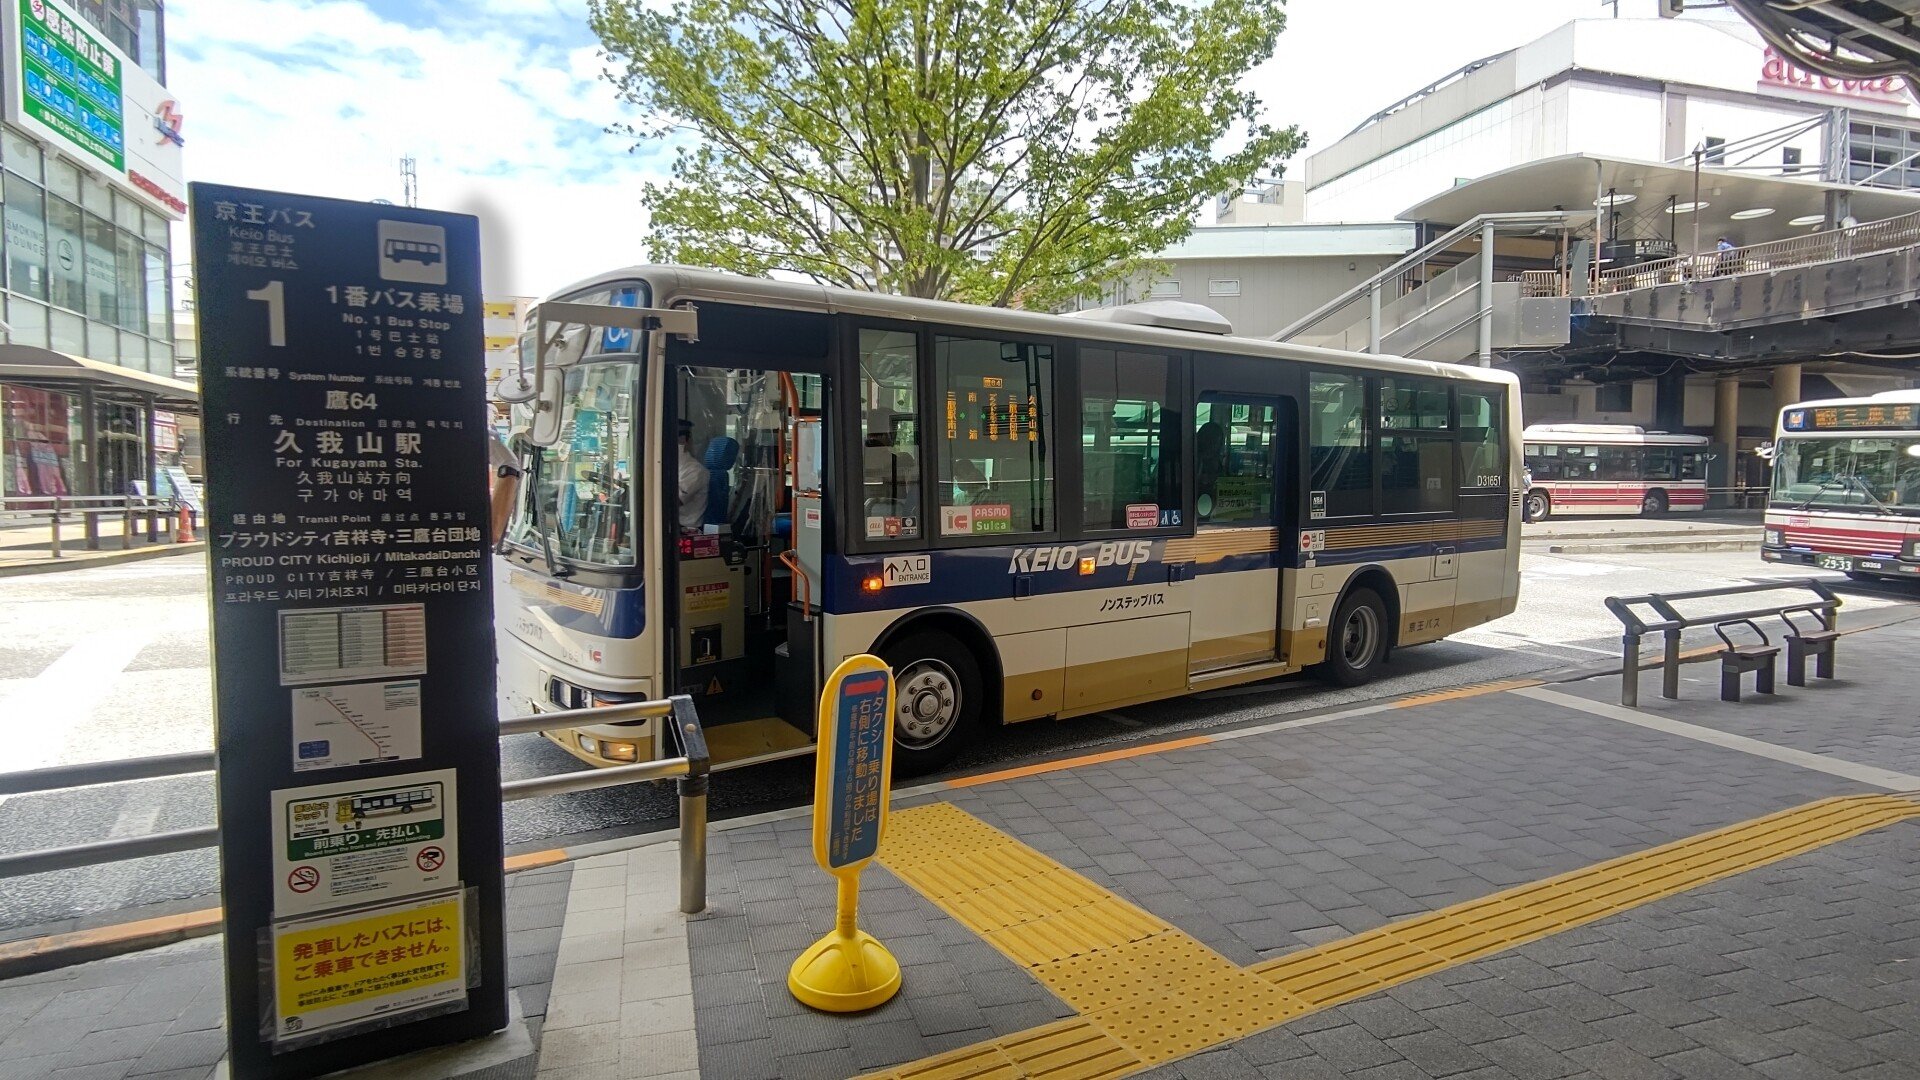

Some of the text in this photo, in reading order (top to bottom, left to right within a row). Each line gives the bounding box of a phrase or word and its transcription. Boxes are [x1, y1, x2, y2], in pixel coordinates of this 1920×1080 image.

[214, 200, 316, 229] 京王バス
[228, 226, 295, 244] Keio Bus
[325, 284, 465, 315] 1番バス乗場
[245, 280, 287, 348] 1
[342, 312, 451, 332] No. 1 Bus Stop
[225, 366, 280, 381] 系統番号
[289, 371, 365, 384] System Number
[325, 389, 377, 411] 鷹64
[296, 417, 365, 429] Destination
[274, 429, 423, 455] 久我山駅
[276, 456, 423, 471] For Kugayama Sta.
[296, 470, 412, 485] 久我山站方向
[232, 512, 287, 526] 経由地
[297, 513, 372, 524] Transit Point
[973, 506, 1009, 518] PASMO
[976, 519, 1007, 532] Suica
[221, 555, 275, 569] PROUD
[279, 554, 313, 567] CITY
[316, 552, 371, 567] Kichijoji
[385, 549, 481, 563] MitakadaiDanchi
[901, 558, 927, 573] 入口
[1008, 540, 1153, 575] KEIO BUS
[225, 573, 276, 586] PROUD
[898, 571, 930, 583] ENTRANCE
[284, 588, 312, 601] 시티
[315, 586, 369, 600] 기치조지
[456, 579, 482, 593] 단지
[1100, 591, 1165, 612] ノンステップバス
[1408, 616, 1441, 633] 京王バス
[865, 696, 885, 823] タクシー乗り場は
[850, 698, 872, 843] 右側に移動しました
[313, 824, 421, 849] 前乗り・先払い
[405, 833, 431, 844] boarding
[293, 916, 452, 962] 発車したバスには、
[293, 938, 451, 983] ご乗車できません。
